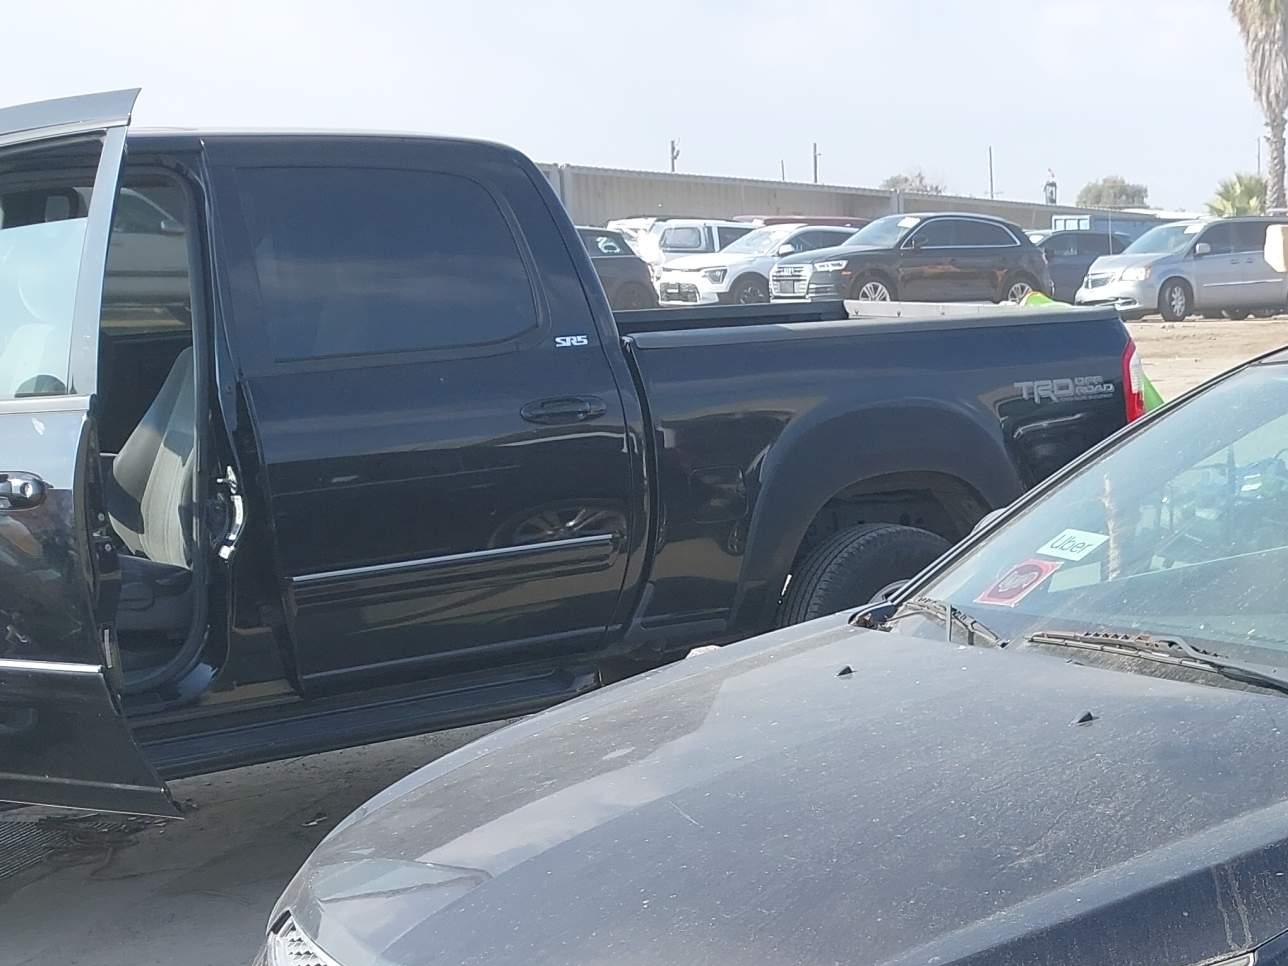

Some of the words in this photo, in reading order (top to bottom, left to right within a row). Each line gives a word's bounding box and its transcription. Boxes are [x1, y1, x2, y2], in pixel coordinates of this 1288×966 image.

[555, 335, 589, 348] SR5
[1013, 378, 1075, 404] TRD
[1050, 533, 1094, 554] Uber
